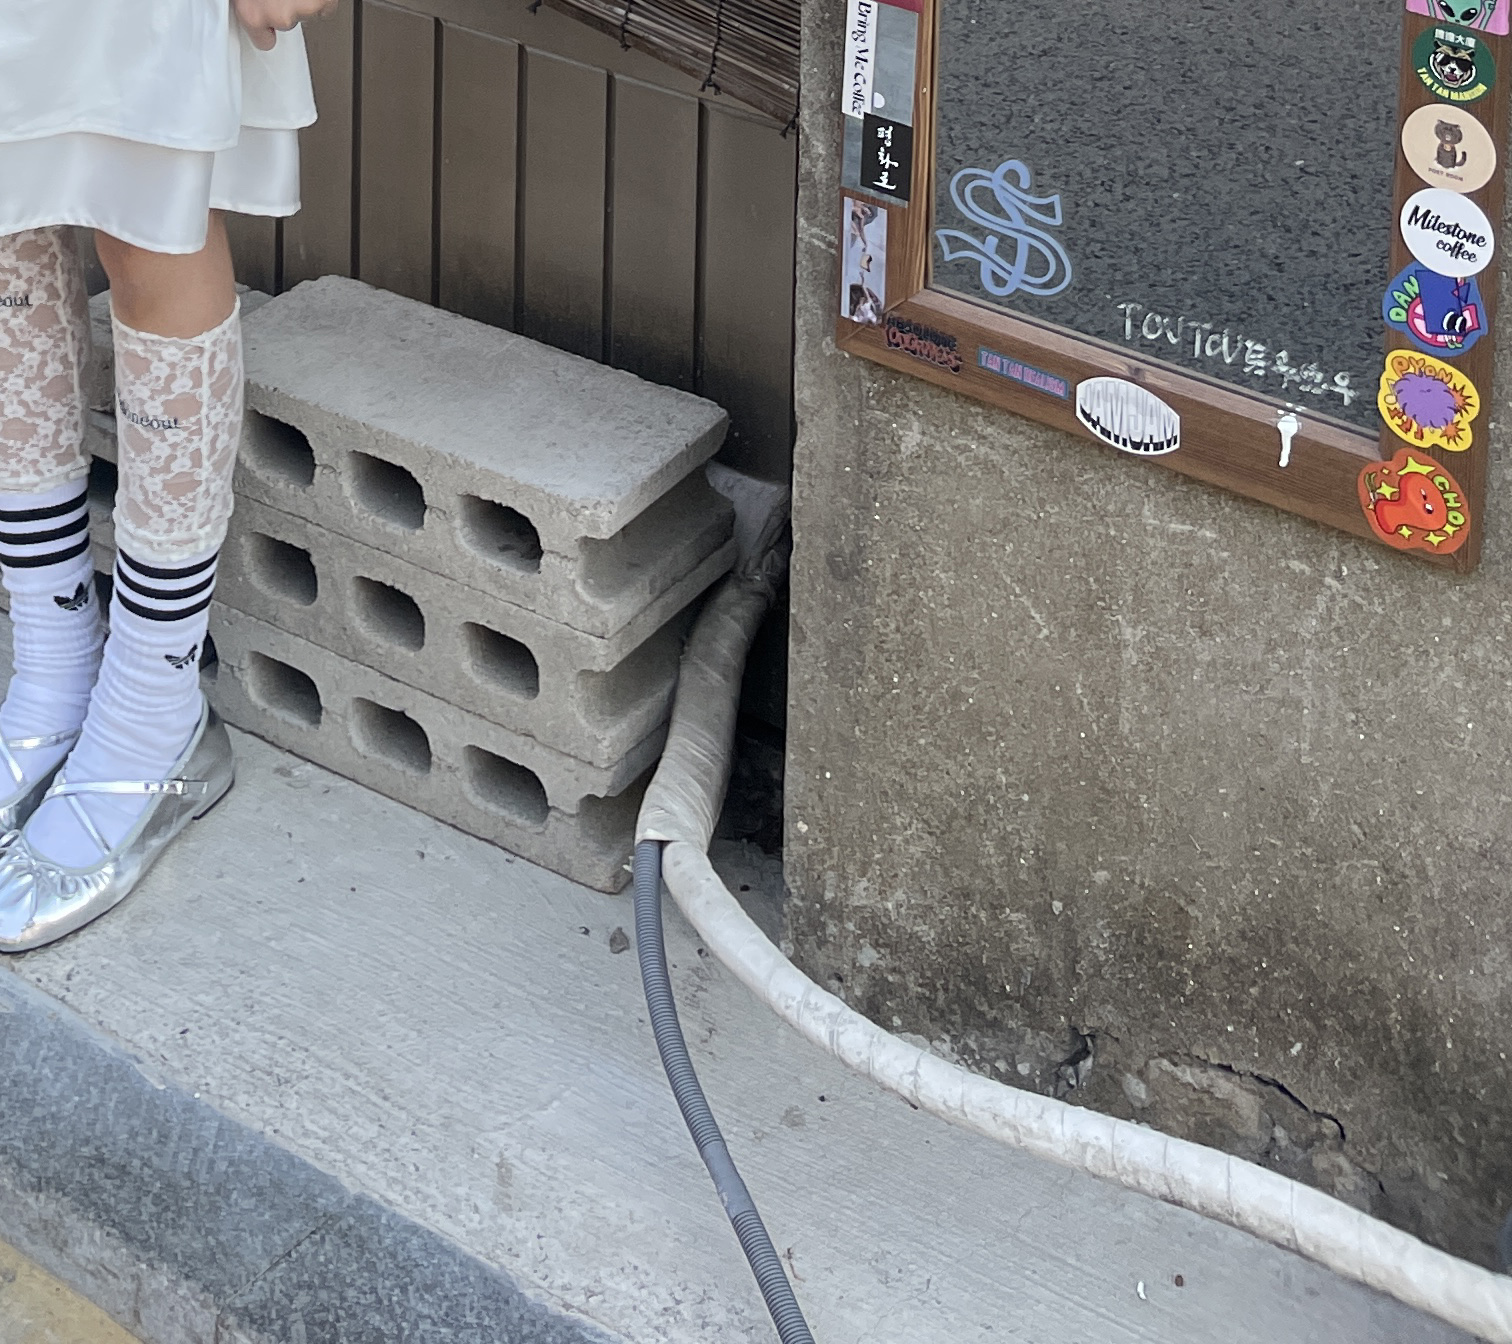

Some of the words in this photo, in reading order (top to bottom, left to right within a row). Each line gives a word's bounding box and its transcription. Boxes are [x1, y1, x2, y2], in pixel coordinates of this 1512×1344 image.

[851, 0, 872, 47] Bring
[855, 45, 870, 72] Me
[851, 70, 867, 116] Coffee
[1407, 204, 1487, 248] Milestone
[1435, 239, 1478, 263] coffee
[1391, 355, 1453, 385] PYON
